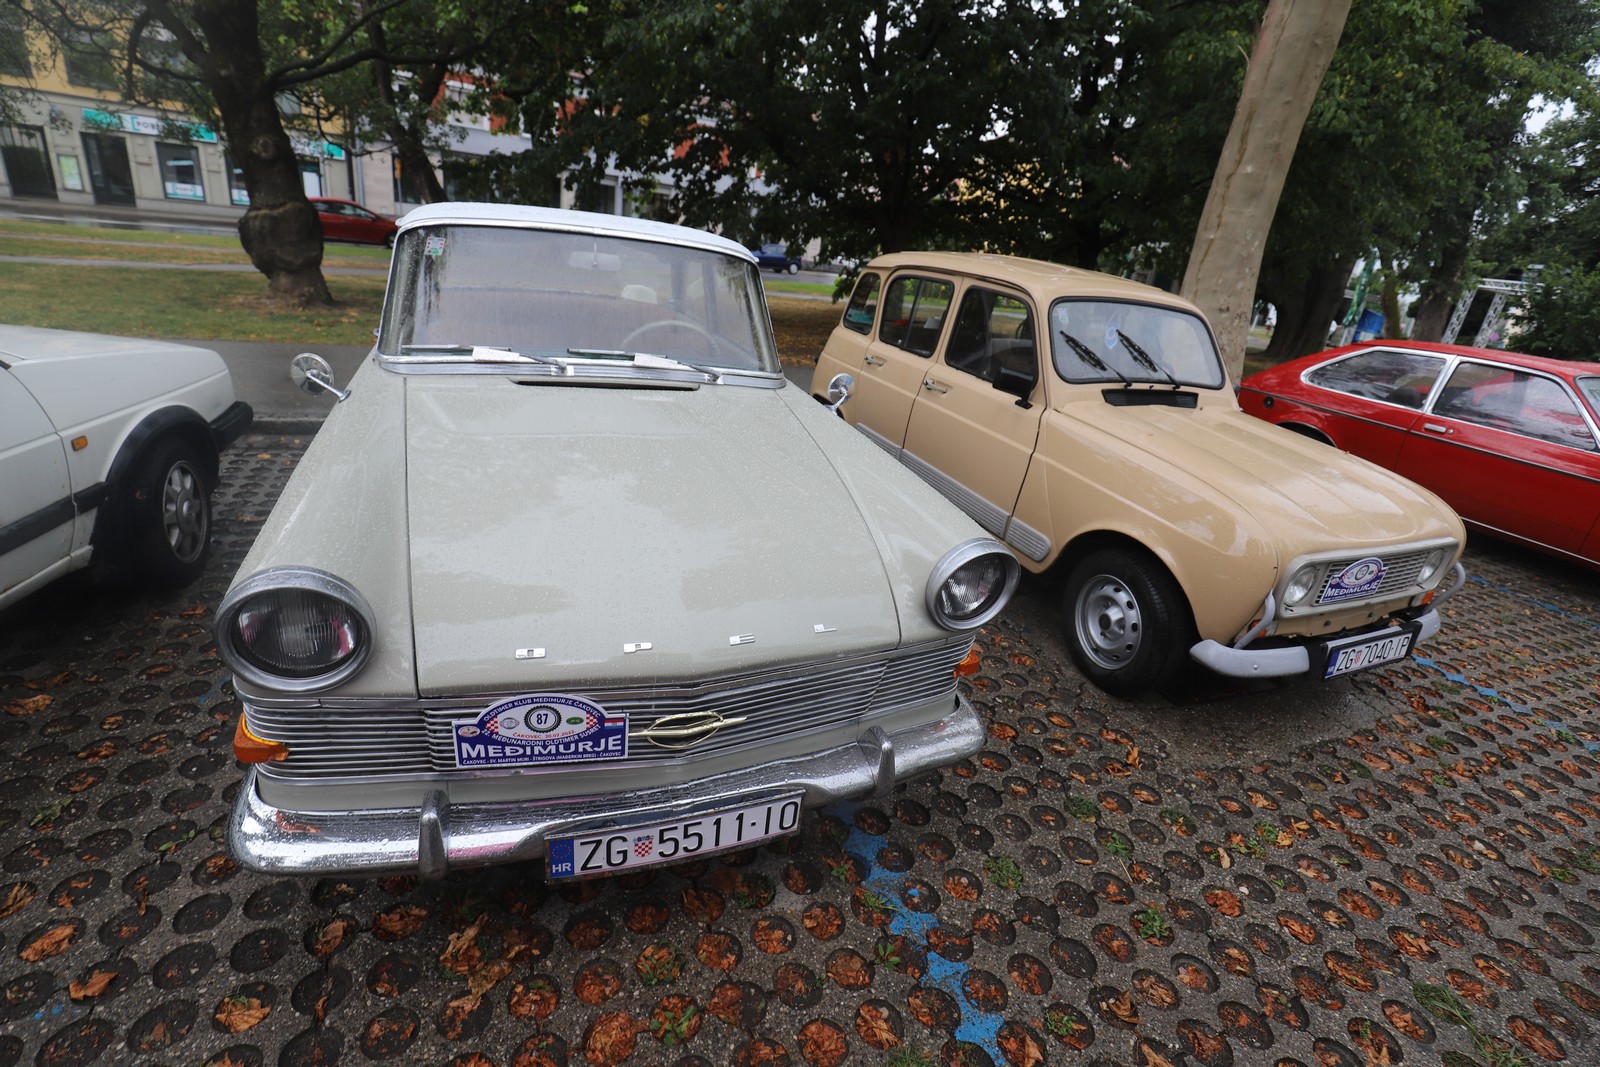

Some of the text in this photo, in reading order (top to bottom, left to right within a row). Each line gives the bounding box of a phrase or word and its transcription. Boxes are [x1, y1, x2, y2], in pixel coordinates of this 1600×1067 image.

[1336, 649, 1356, 672] ZG
[483, 702, 514, 722] OLDTIMER
[514, 698, 532, 706] KLUB
[536, 713, 549, 725] 87
[545, 734, 579, 746] OLDTIMER
[579, 723, 602, 739] SUSRET
[579, 835, 629, 872] ZG
[551, 862, 572, 874] HR
